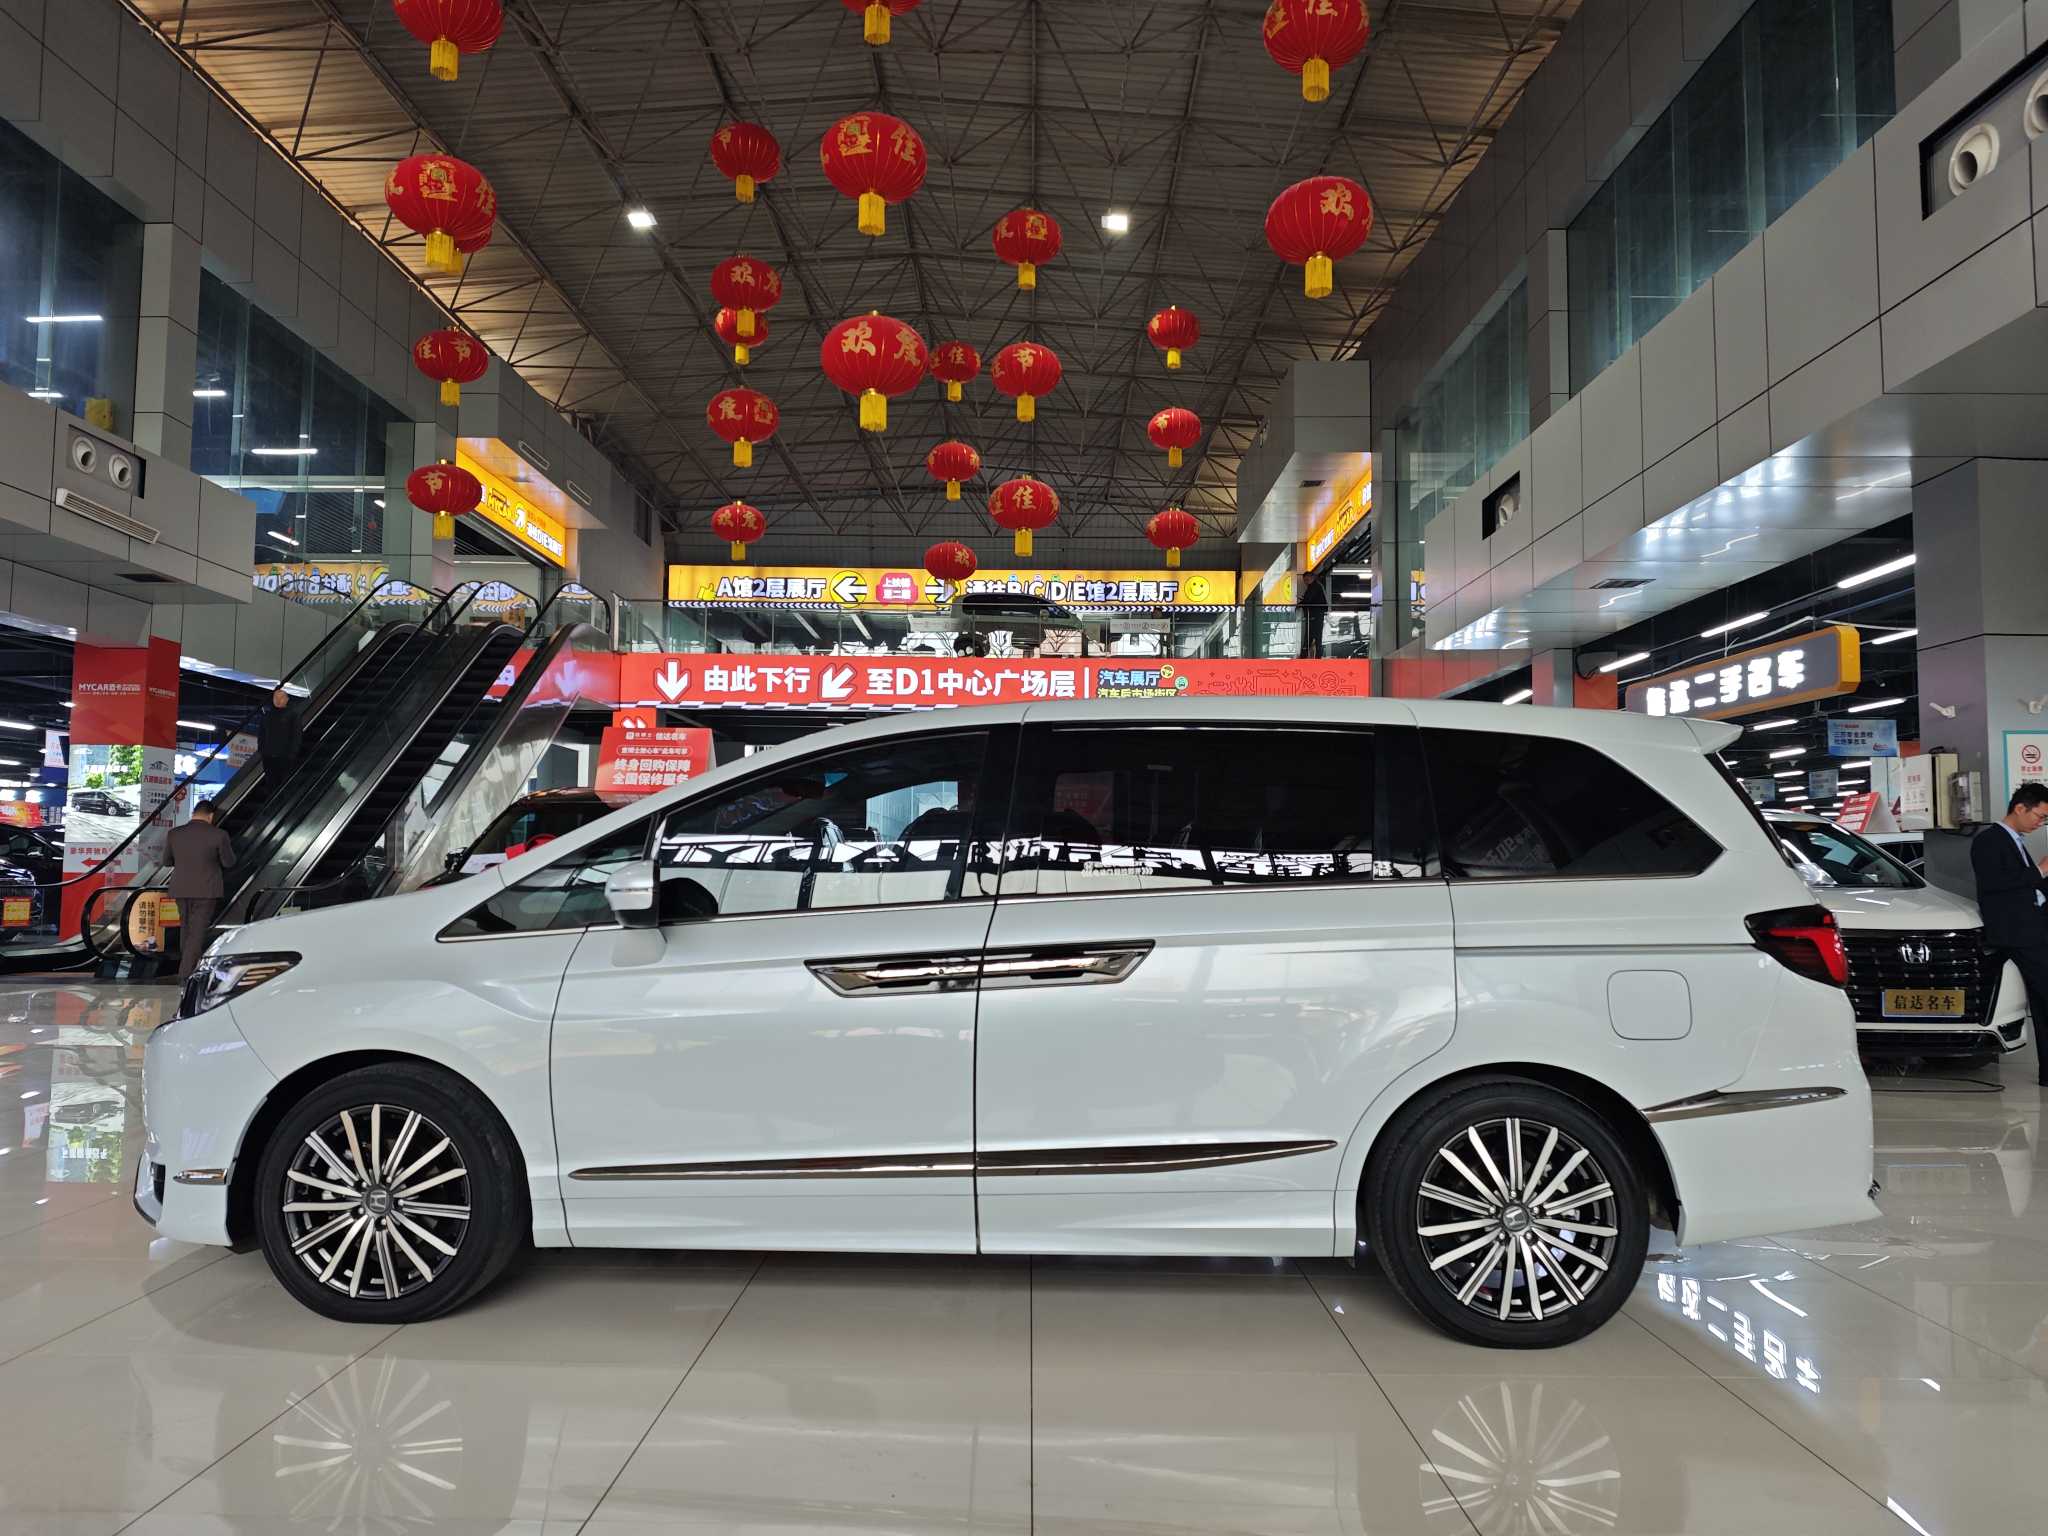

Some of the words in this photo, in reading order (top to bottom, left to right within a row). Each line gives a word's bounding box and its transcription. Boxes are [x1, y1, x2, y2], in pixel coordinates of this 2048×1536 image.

[716, 576, 827, 599] A馆2层展厅
[703, 665, 811, 693] 由此下行
[865, 667, 1076, 697] 至D1中心广场层
[1099, 669, 1161, 686] 汽车展厅
[614, 758, 691, 772] 终身回购保障
[1894, 994, 1956, 1011] 信达名车
